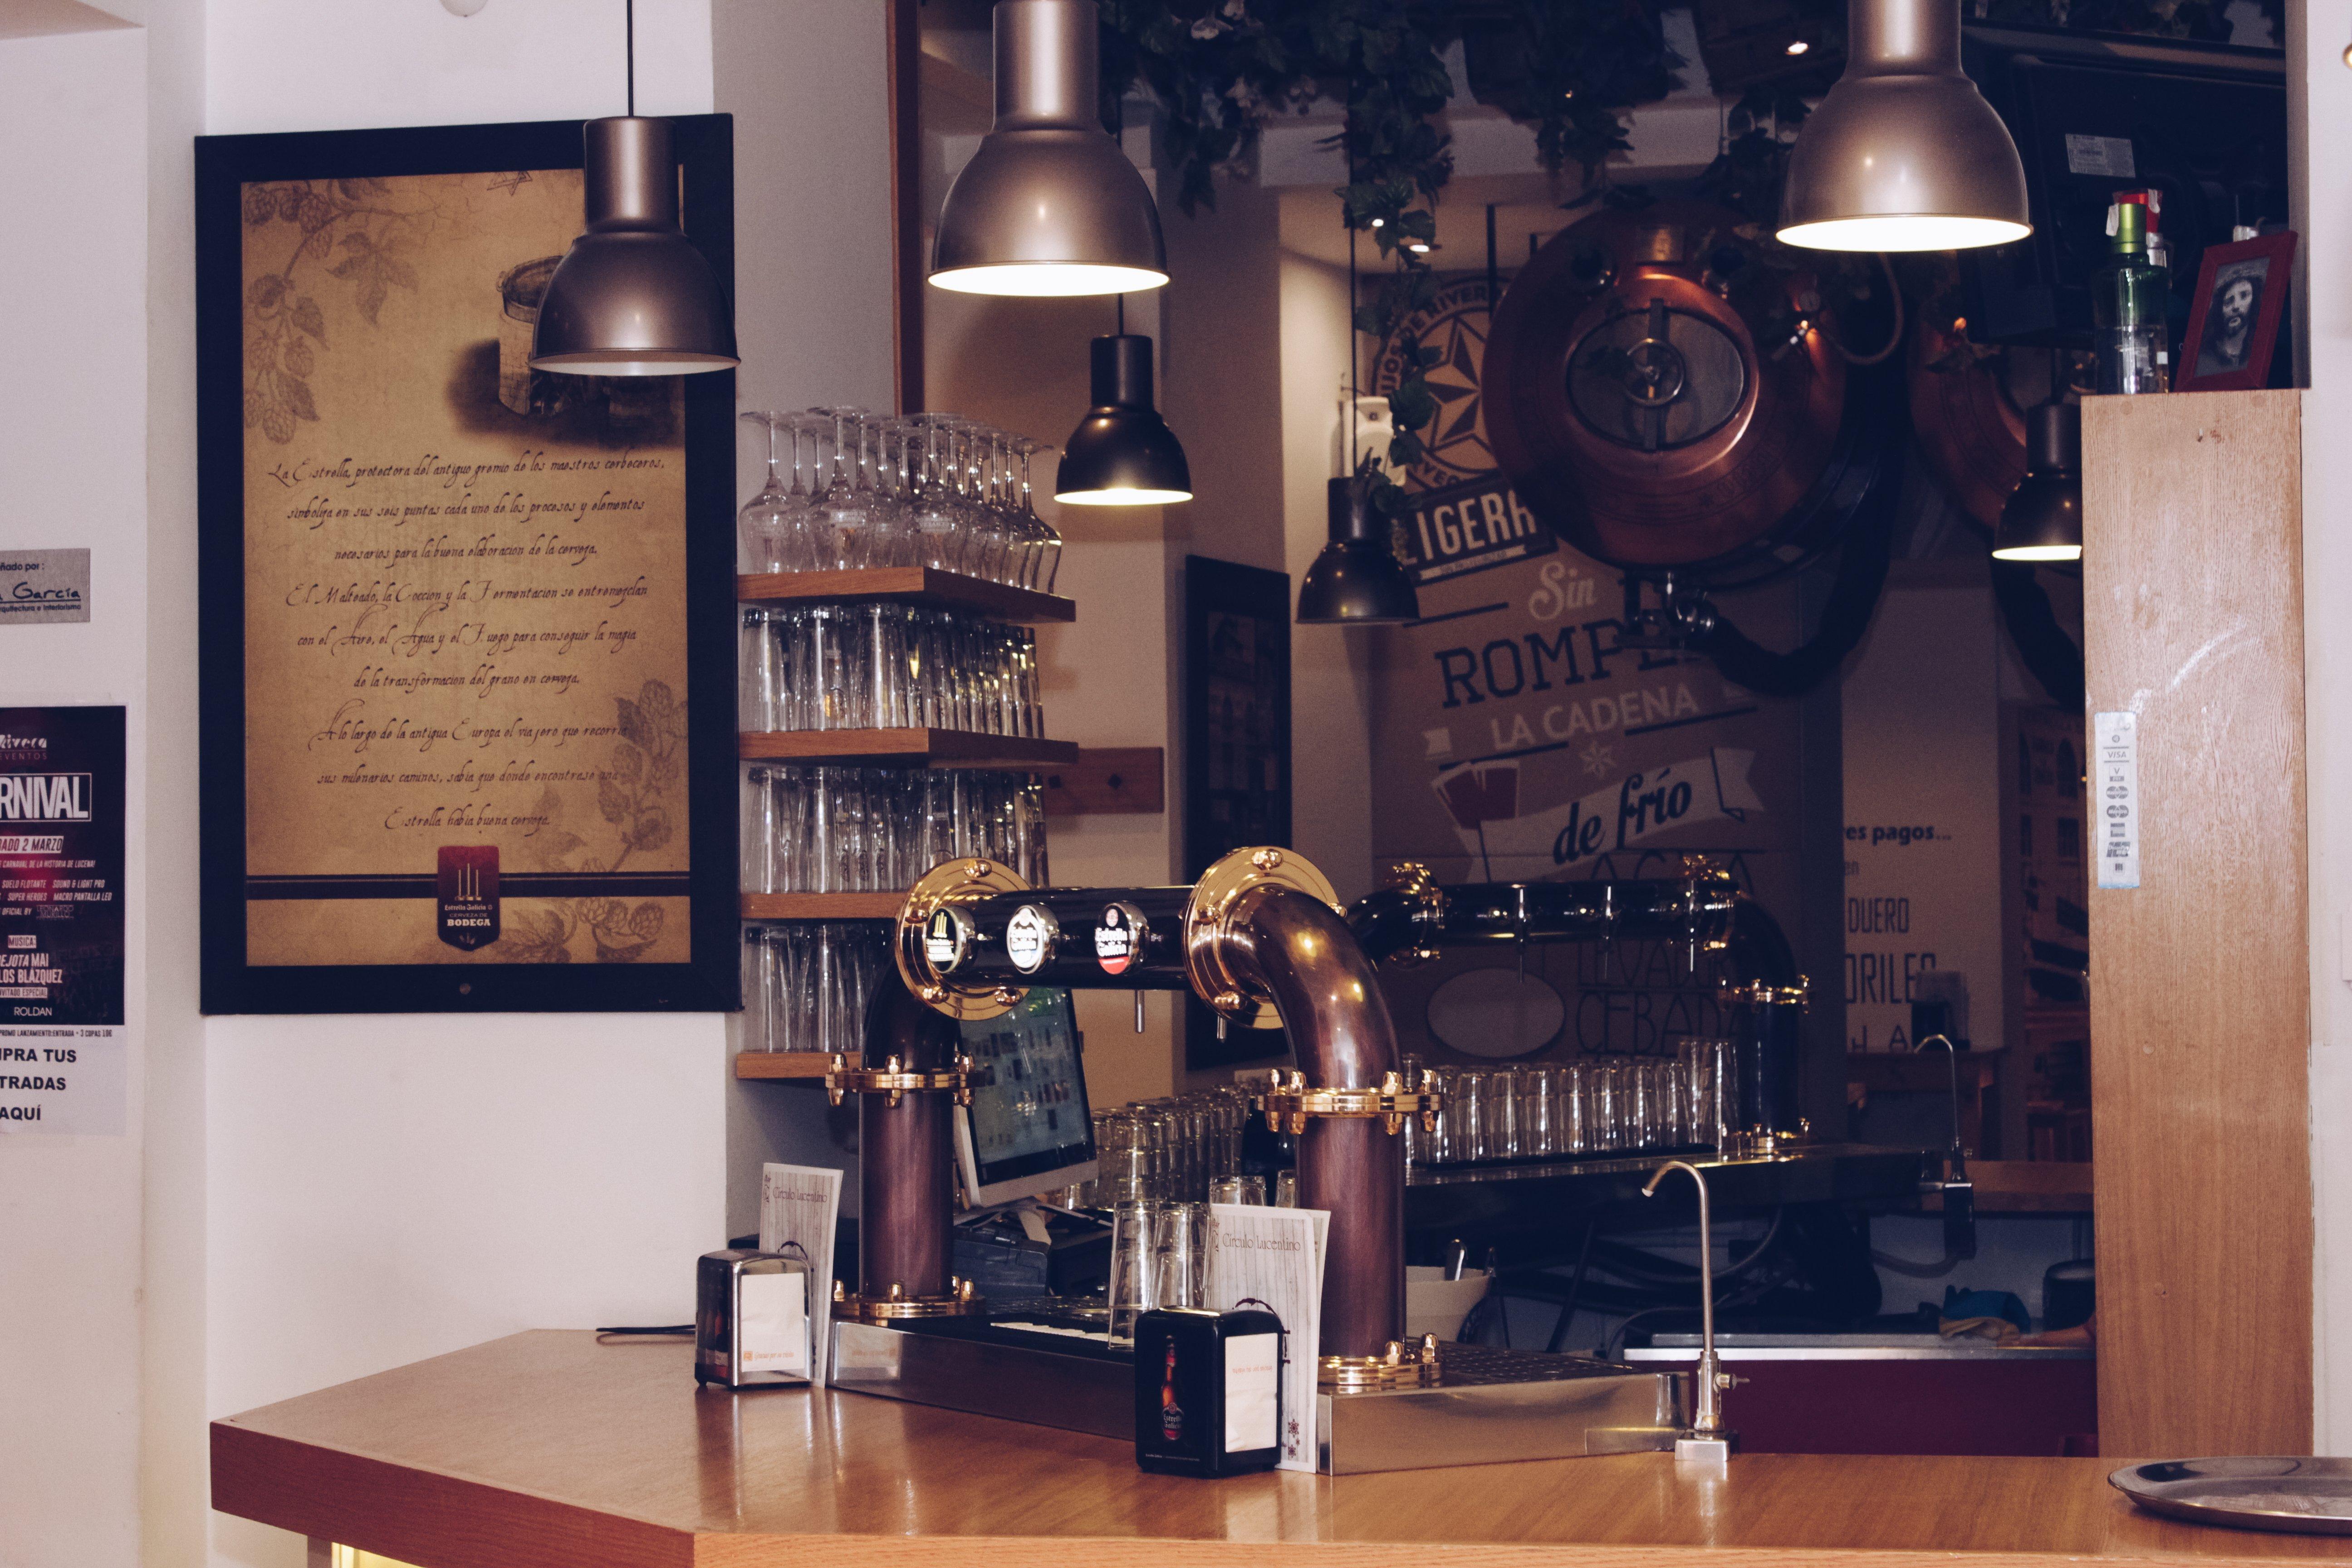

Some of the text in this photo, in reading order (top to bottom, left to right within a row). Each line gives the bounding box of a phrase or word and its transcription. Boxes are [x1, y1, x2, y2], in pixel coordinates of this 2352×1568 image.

[268, 463, 291, 488] La
[292, 458, 352, 482] Estrella,
[346, 465, 410, 488] protectora
[413, 454, 439, 475] del
[433, 463, 471, 488] antiguo
[464, 463, 509, 488] gremio
[514, 450, 530, 472] de
[530, 451, 545, 471] los
[550, 459, 600, 470] maestros
[336, 509, 348, 518] en
[353, 507, 372, 517] sus
[377, 507, 400, 517] seis
[394, 505, 441, 526] puntas
[444, 493, 471, 514] cada
[471, 505, 490, 514] uno
[493, 491, 510, 513] de
[510, 493, 524, 513] los
[520, 501, 576, 523] procesos
[573, 502, 588, 523] y
[592, 491, 645, 511] elementos
[335, 549, 390, 559] necesarios
[385, 549, 418, 569] para
[421, 538, 435, 558] la
[434, 535, 464, 558] buena
[468, 534, 524, 557] elaboracion
[528, 534, 545, 555] de
[544, 535, 559, 554] la
[25, 564, 39, 572] por
[12, 581, 81, 600] García
[286, 583, 319, 606] El
[315, 581, 380, 604] Malteado,
[382, 583, 396, 603] la
[439, 591, 452, 612] y
[457, 580, 470, 600] la
[470, 580, 558, 603] Fermentacion
[561, 588, 573, 597] se
[578, 576, 647, 608] entremezclan
[1528, 560, 1597, 622] Sin
[298, 637, 314, 646] con
[318, 626, 337, 646] el
[379, 624, 398, 644] el
[431, 635, 445, 654] y
[451, 623, 469, 643] el
[503, 633, 536, 652] para
[539, 633, 590, 655] conseguir
[594, 620, 608, 640] la
[608, 631, 637, 654] magia
[354, 666, 371, 687] de
[370, 667, 383, 687] la
[383, 672, 465, 694] transformacion
[470, 663, 495, 685] del
[523, 675, 536, 684] en
[479, 675, 519, 699] grano
[1492, 683, 1701, 750] LA CADENA
[338, 720, 352, 740] lo
[351, 720, 377, 753] largo
[380, 717, 397, 739] de
[397, 719, 410, 739] la
[409, 728, 448, 752] antigua
[452, 717, 500, 748] Europa
[504, 717, 523, 737] el
[519, 728, 558, 748] viajero
[554, 727, 579, 748] que
[318, 774, 336, 784] sus
[342, 763, 395, 783] milenarios
[398, 772, 442, 783] caminos,
[470, 772, 495, 793] que
[499, 760, 535, 782] donde
[385, 806, 445, 829] Estrella
[476, 803, 508, 826] buena
[1553, 768, 1693, 865] de frío
[0, 838, 64, 852] ADO 2 MARZO
[2, 880, 20, 889] SUELO
[20, 880, 47, 888] FLOTANTE
[52, 879, 71, 888] SOUND
[77, 879, 93, 888] LIGHT
[94, 879, 105, 888] PRO
[7, 892, 25, 902] SUPER
[53, 892, 73, 901] MACRO
[74, 892, 100, 901] PANTALLA
[101, 892, 113, 901] LED
[446, 918, 491, 926] BODEGA
[1848, 897, 1910, 934] DUERO
[31, 953, 49, 967] MAI
[18, 967, 64, 985] BLÁZQUEZ
[22, 988, 47, 997] ESPECIAL
[14, 1007, 53, 1016] ROLDAN
[43, 1049, 77, 1063] TUS
[0, 1076, 67, 1091] TRADAS
[0, 1104, 41, 1121] AQUÍ
[796, 1189, 828, 1203] Lucentino
[1222, 1233, 1301, 1252] Círculo Lucentino
